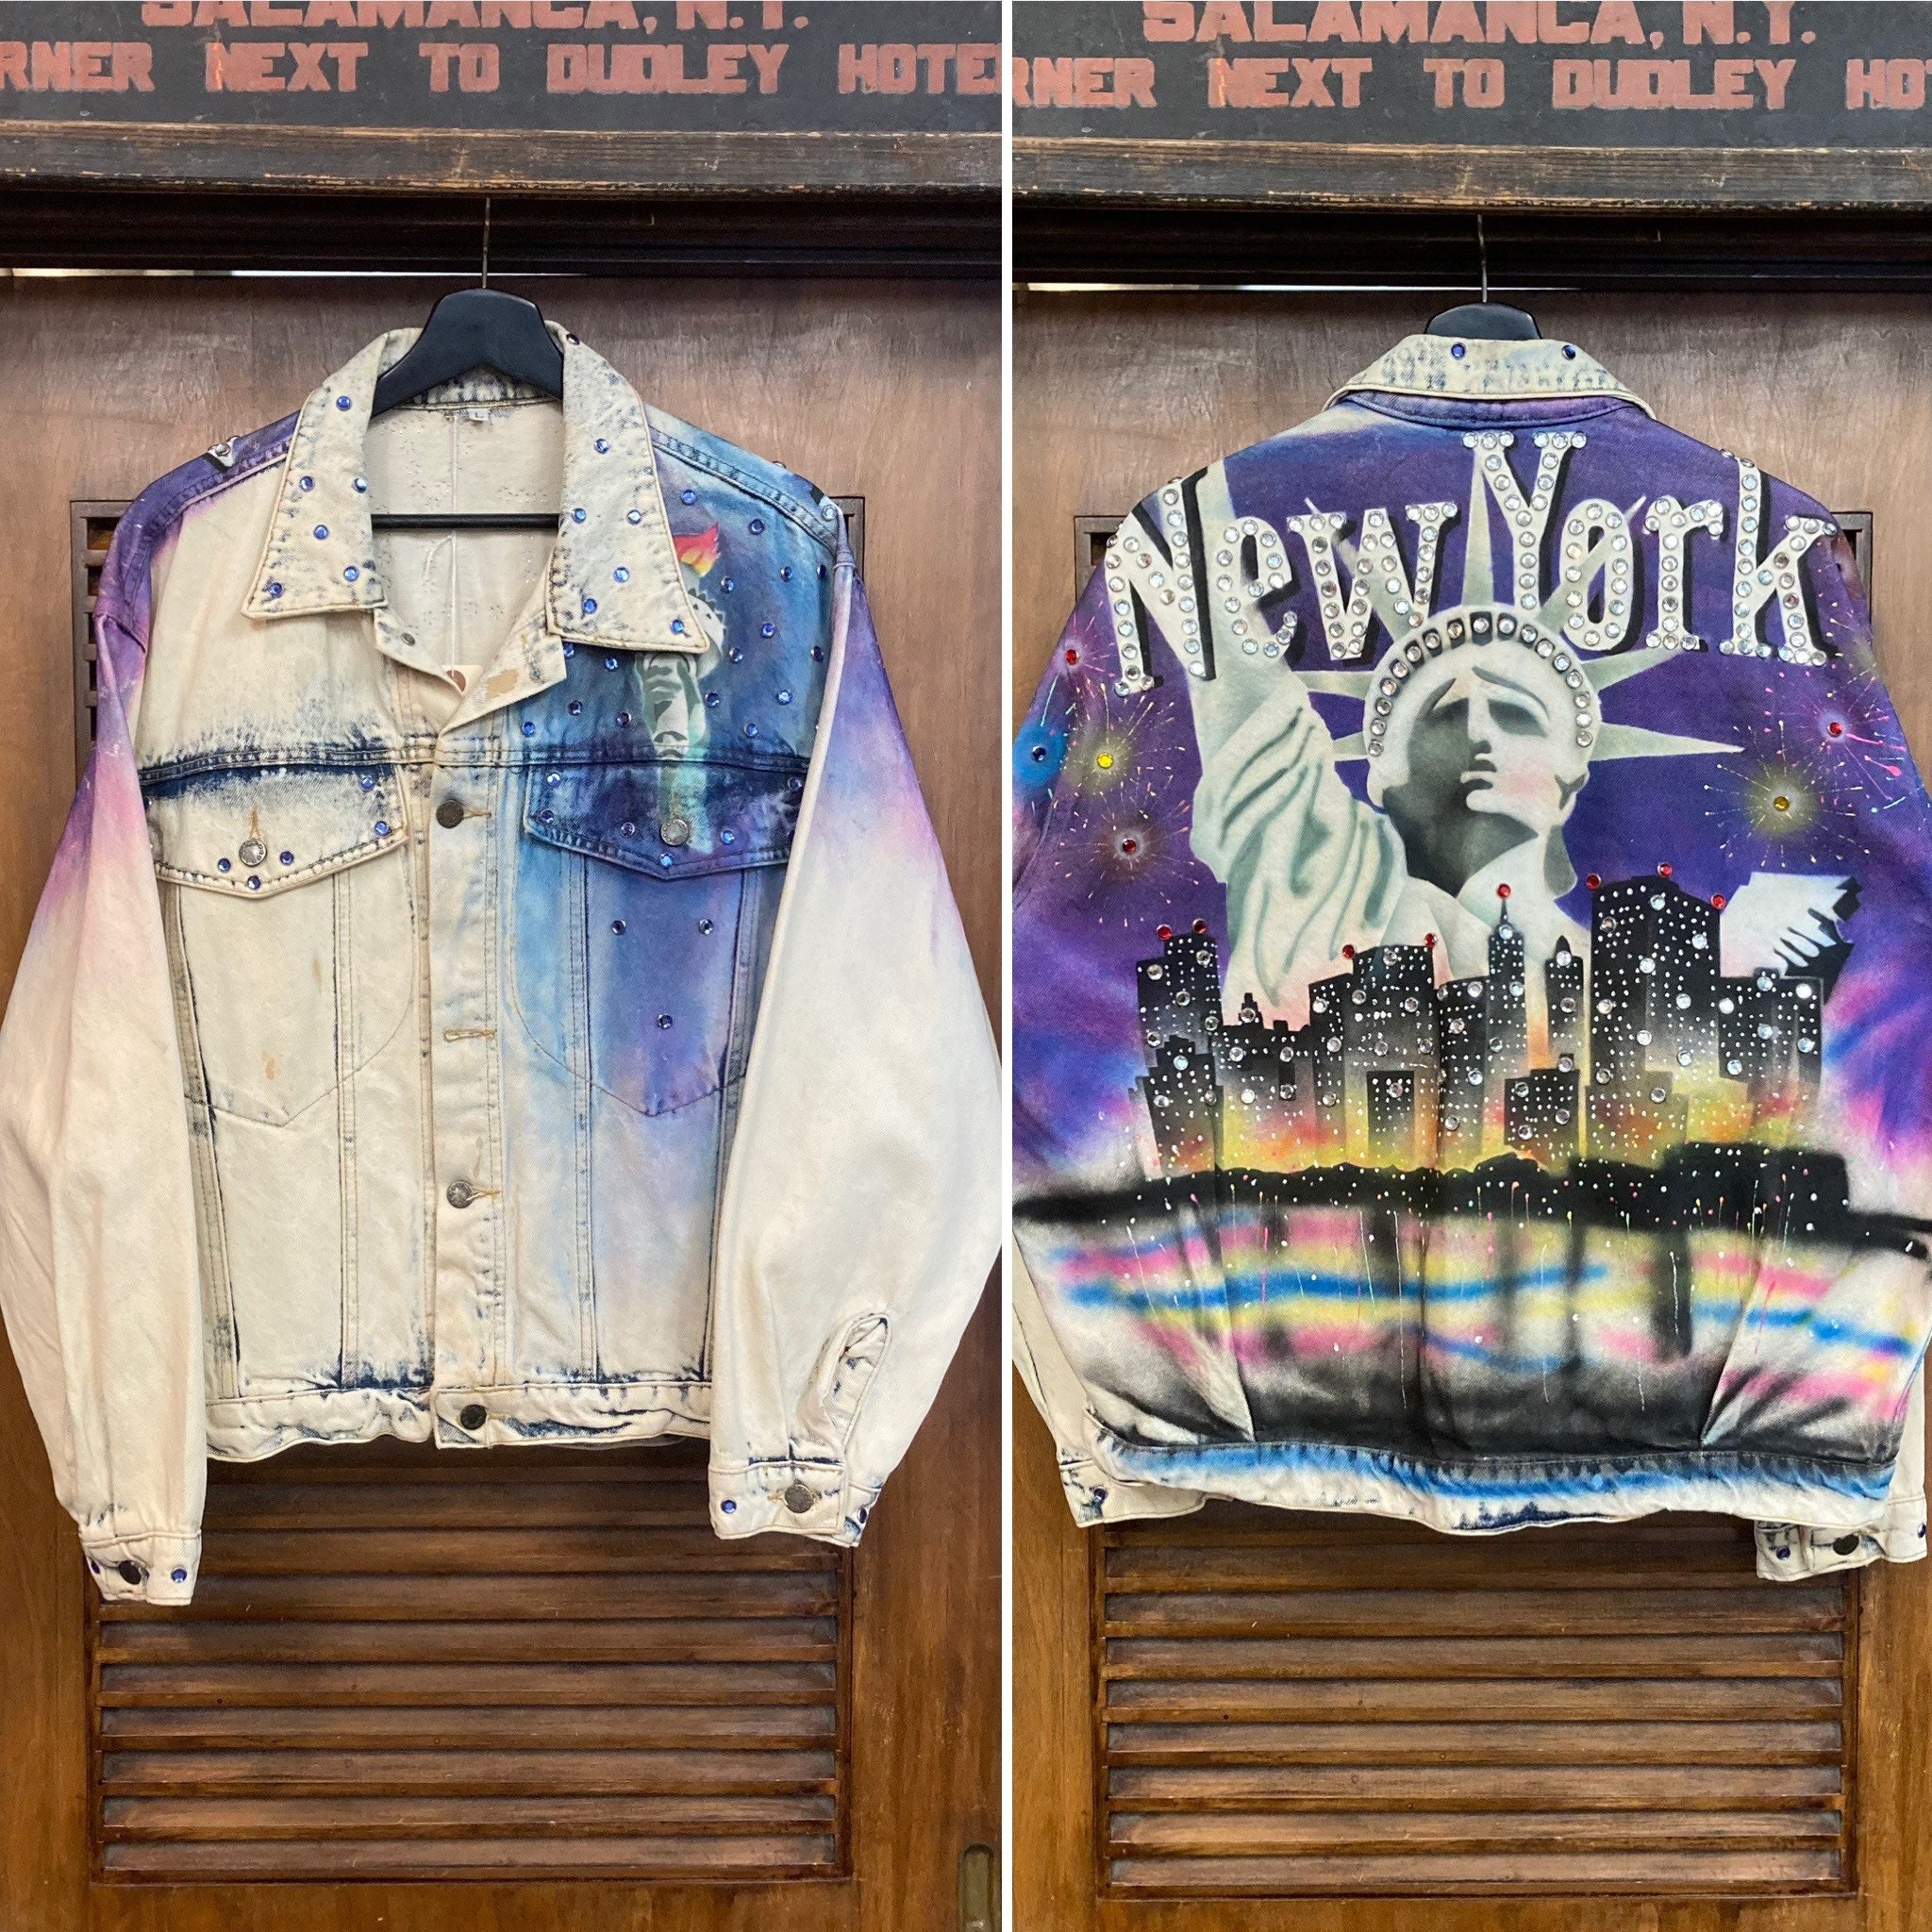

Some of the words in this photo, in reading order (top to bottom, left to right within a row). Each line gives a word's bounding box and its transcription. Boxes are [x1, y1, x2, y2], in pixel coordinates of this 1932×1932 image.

[1142, 0, 1664, 49] SALAMANCA,
[1683, 0, 1816, 45] N.Y.
[205, 42, 369, 92] NEXT
[418, 42, 499, 93] TO
[547, 43, 790, 94] DUDLEY
[1208, 58, 1373, 108] NEXT
[1423, 58, 1505, 108] TO
[1552, 58, 1796, 109] DUDLEY
[1460, 429, 1841, 668] York
